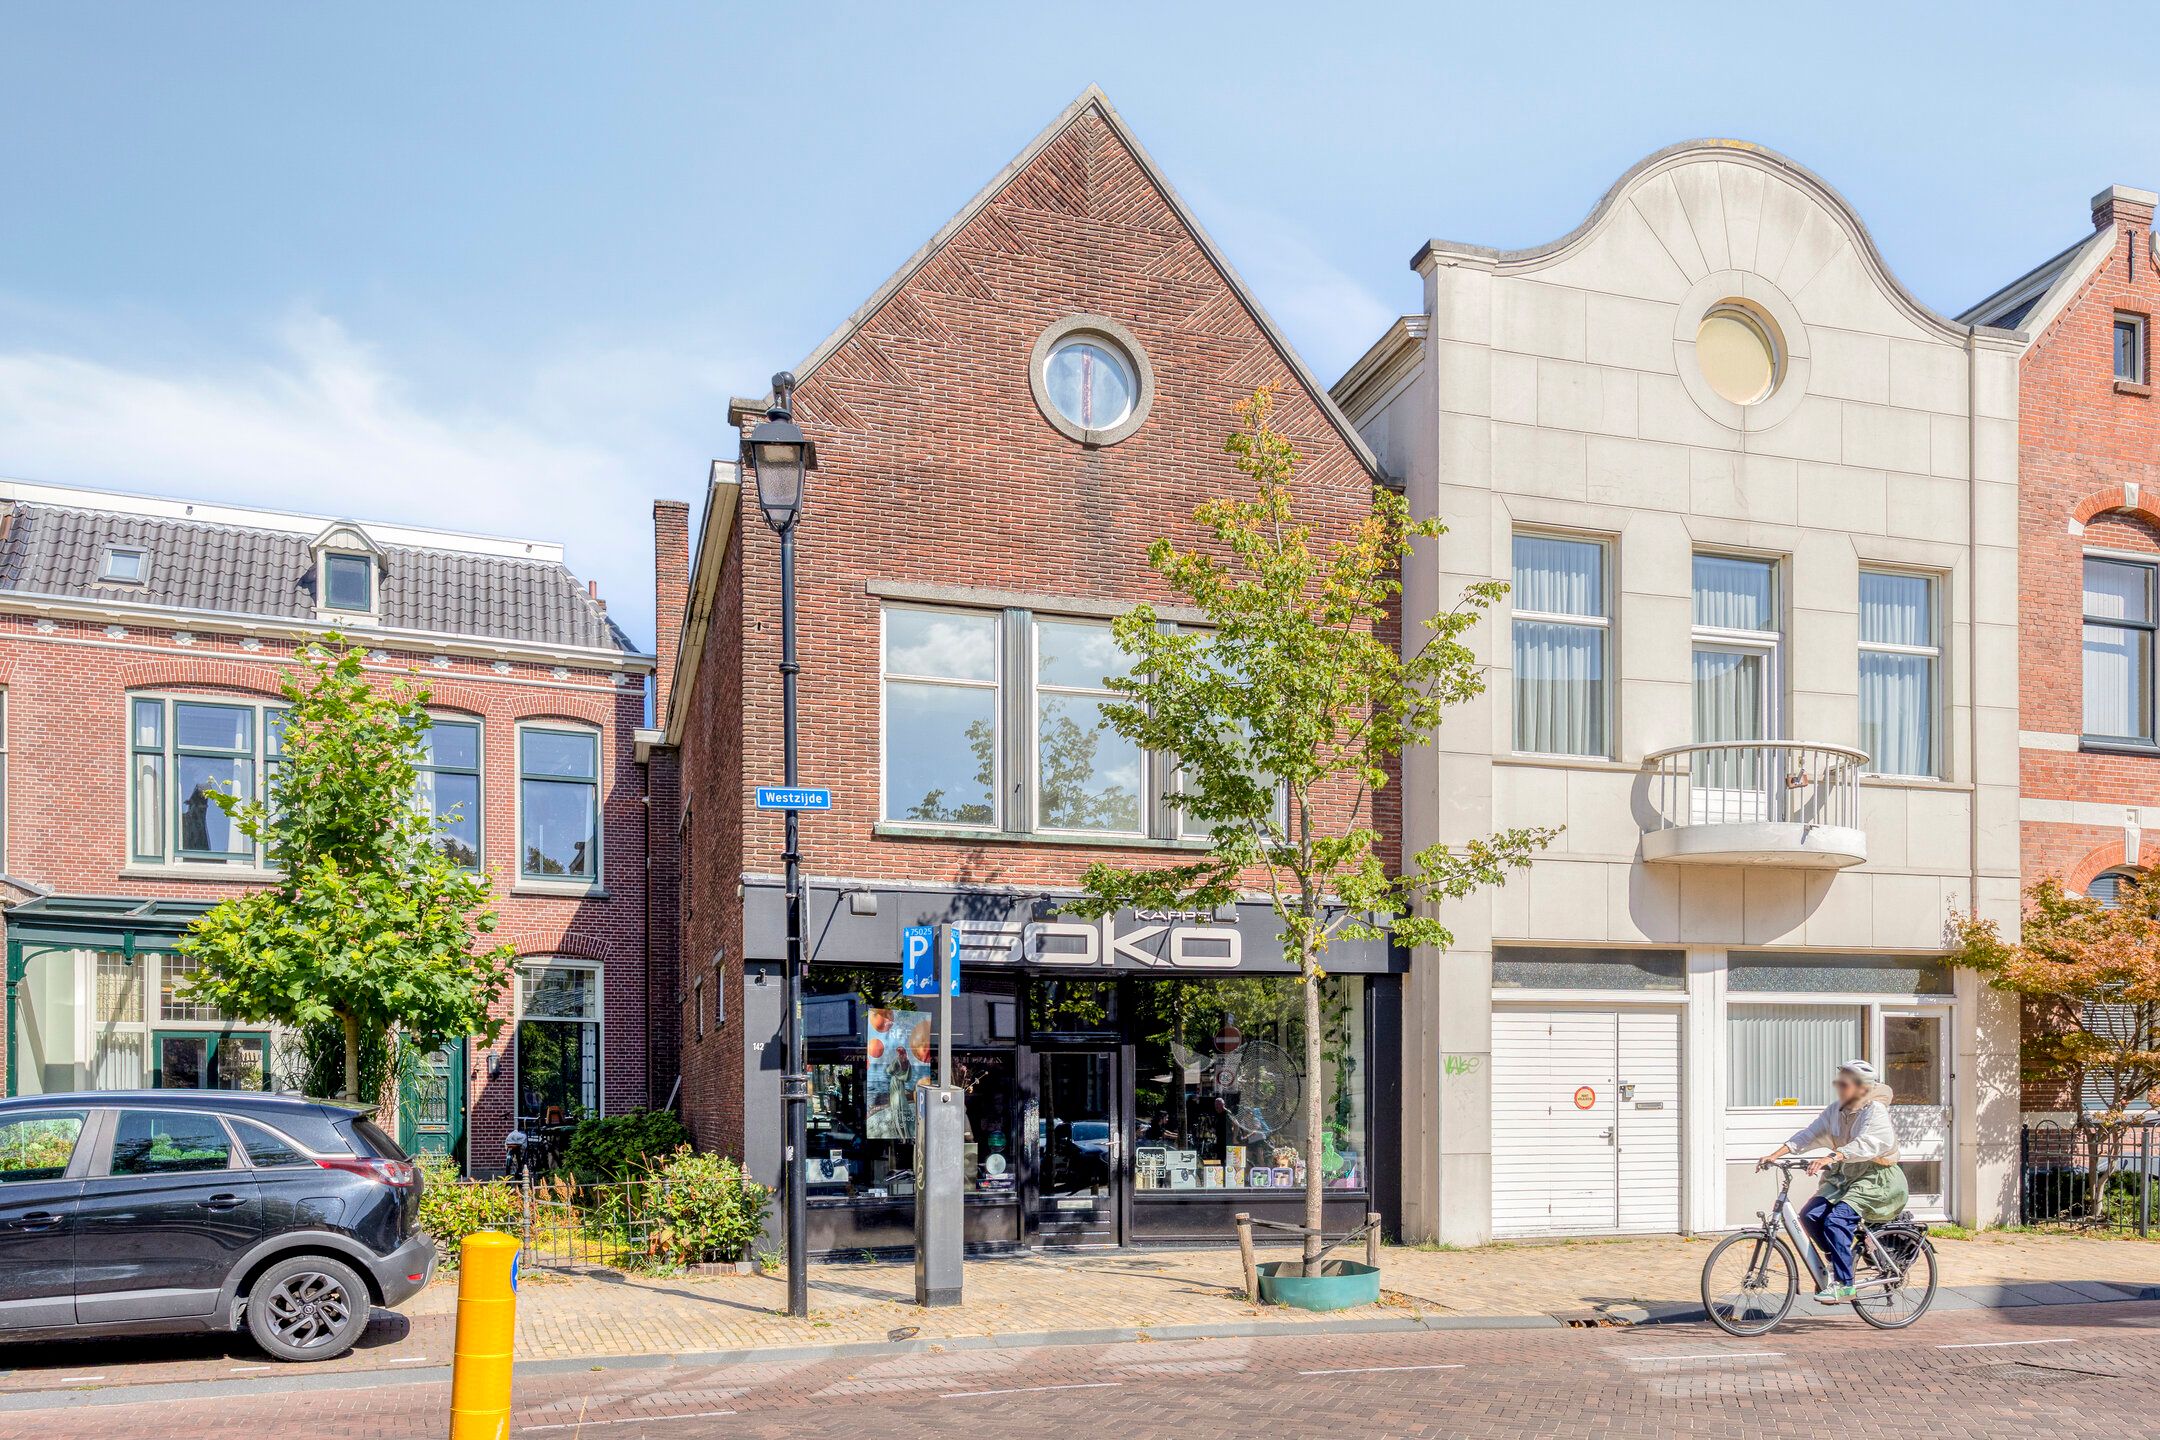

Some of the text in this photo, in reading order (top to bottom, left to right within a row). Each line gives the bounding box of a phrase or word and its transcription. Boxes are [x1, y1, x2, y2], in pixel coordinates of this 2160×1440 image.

[765, 792, 822, 806] Westzijde
[910, 927, 933, 936] 75025
[909, 935, 929, 970] P
[753, 1042, 764, 1051] 142
